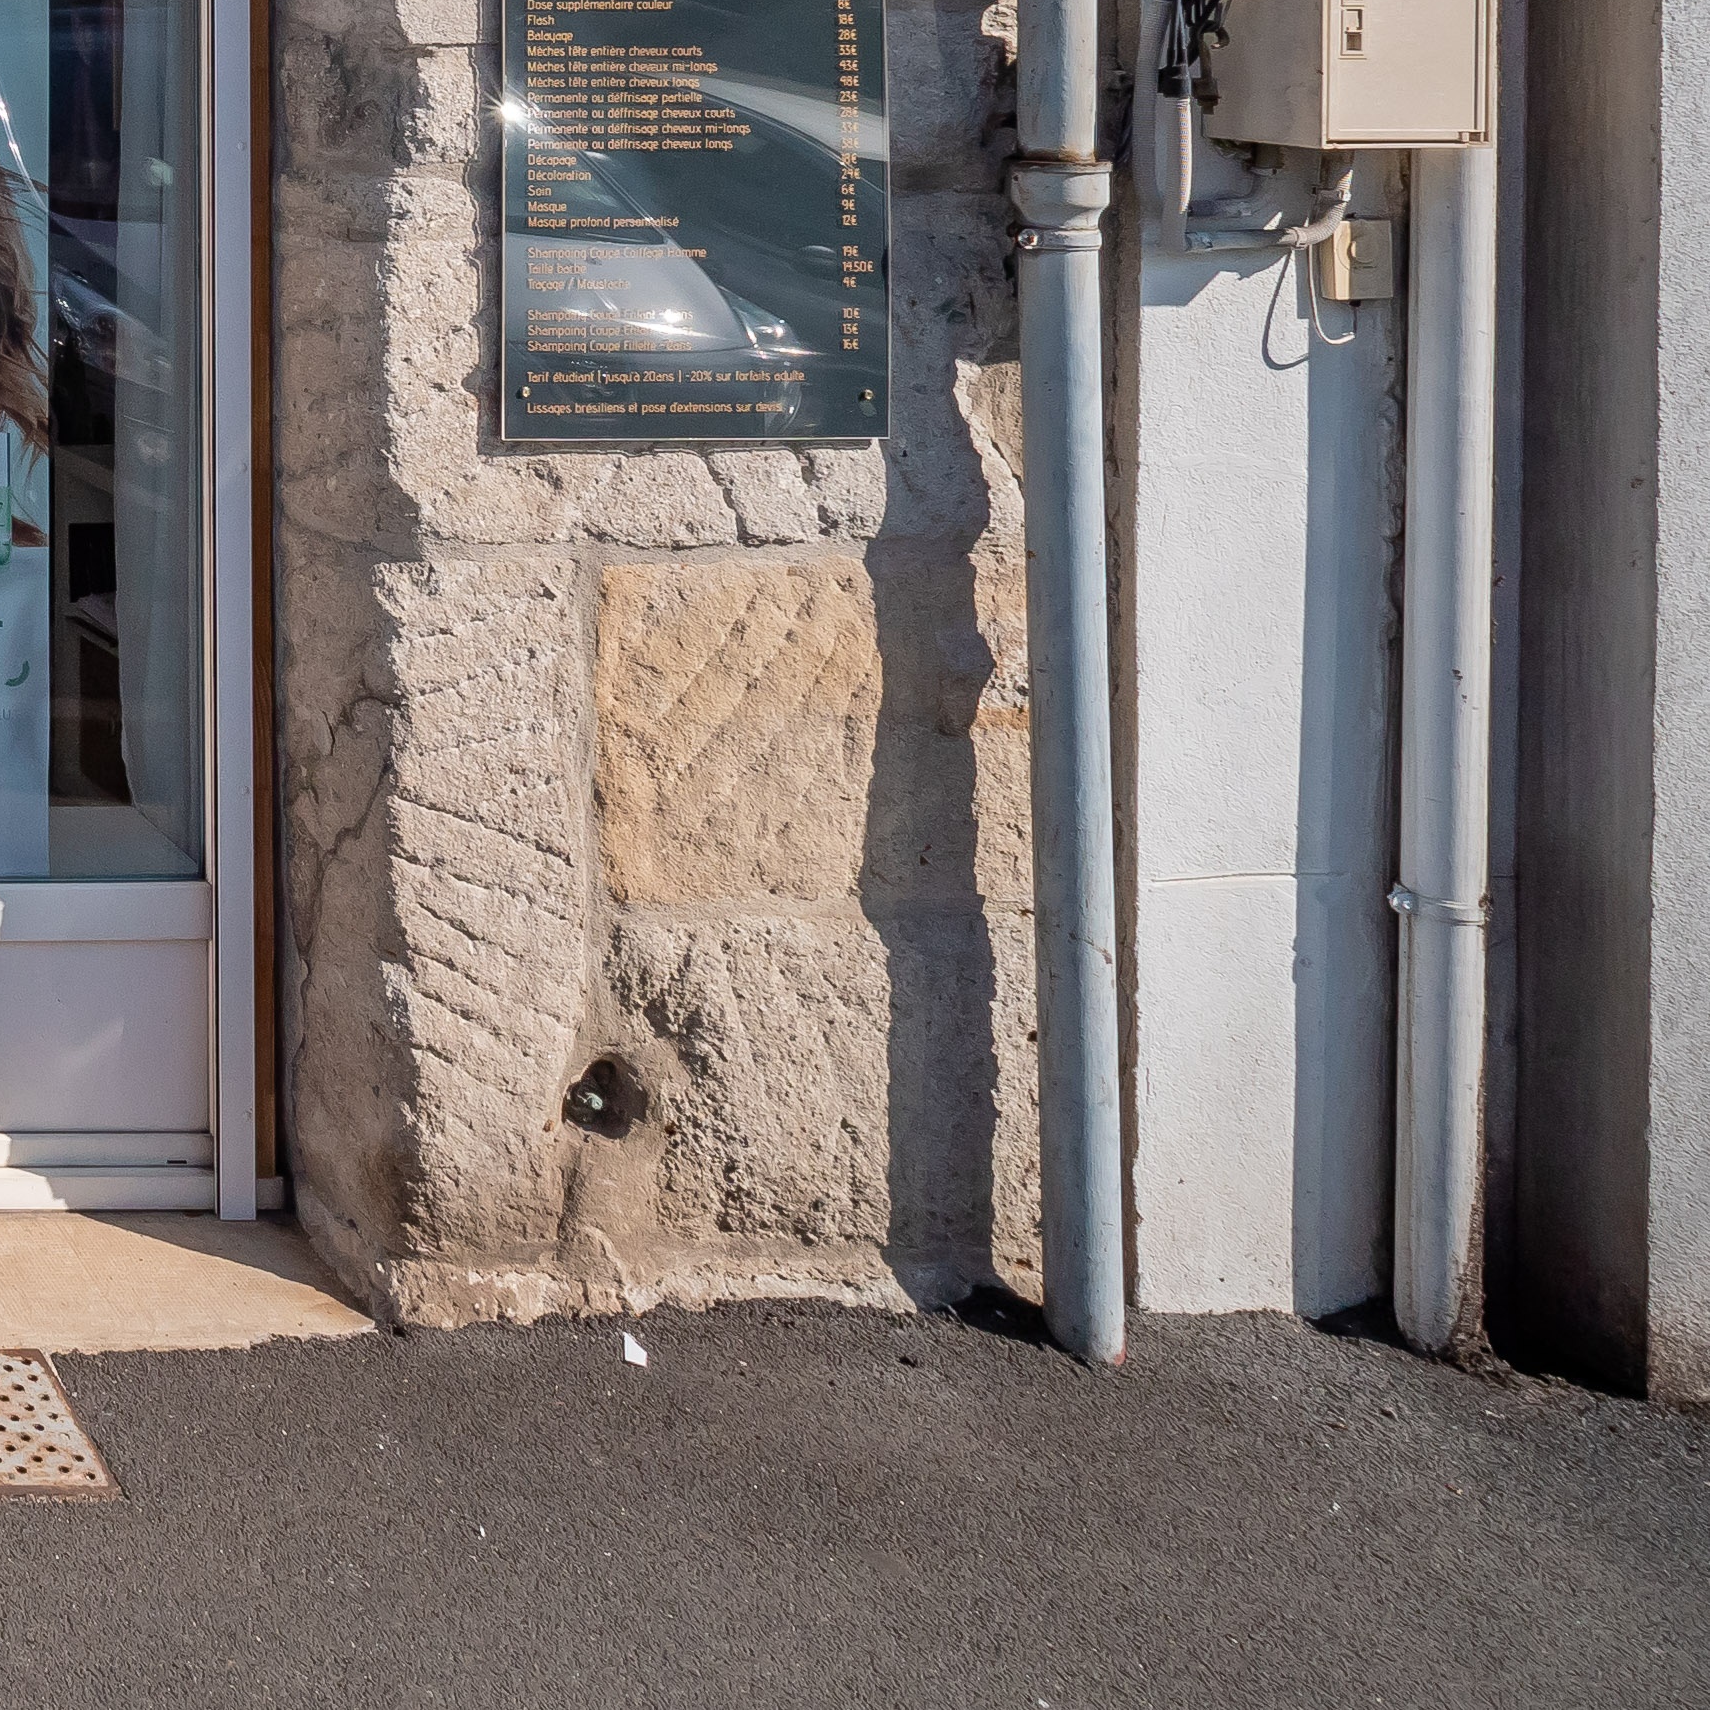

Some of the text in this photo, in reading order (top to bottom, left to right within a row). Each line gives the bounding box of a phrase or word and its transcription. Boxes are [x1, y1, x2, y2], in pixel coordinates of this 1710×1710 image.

[527, 0, 553, 10] Dose
[557, 0, 633, 12] supplémentaire
[637, 0, 673, 10] couleur
[527, 13, 854, 26] Flash 18€
[527, 29, 857, 43] Balayage 28€
[528, 93, 588, 103] Permanente
[591, 94, 605, 103] ou
[608, 93, 658, 105] déffrisage
[662, 93, 702, 105] partielle
[528, 170, 591, 181] Décoloration
[528, 184, 855, 196] Soin 6€
[528, 200, 855, 214] Masque 9€
[528, 217, 567, 229] Masque
[570, 217, 610, 230] profond
[842, 216, 858, 226] 12€
[527, 403, 572, 414] Lissages
[575, 403, 625, 414] brésiliens
[628, 403, 638, 413] et
[642, 405, 666, 415] pose
[670, 403, 732, 413] d'extensions
[736, 404, 752, 413] sur
